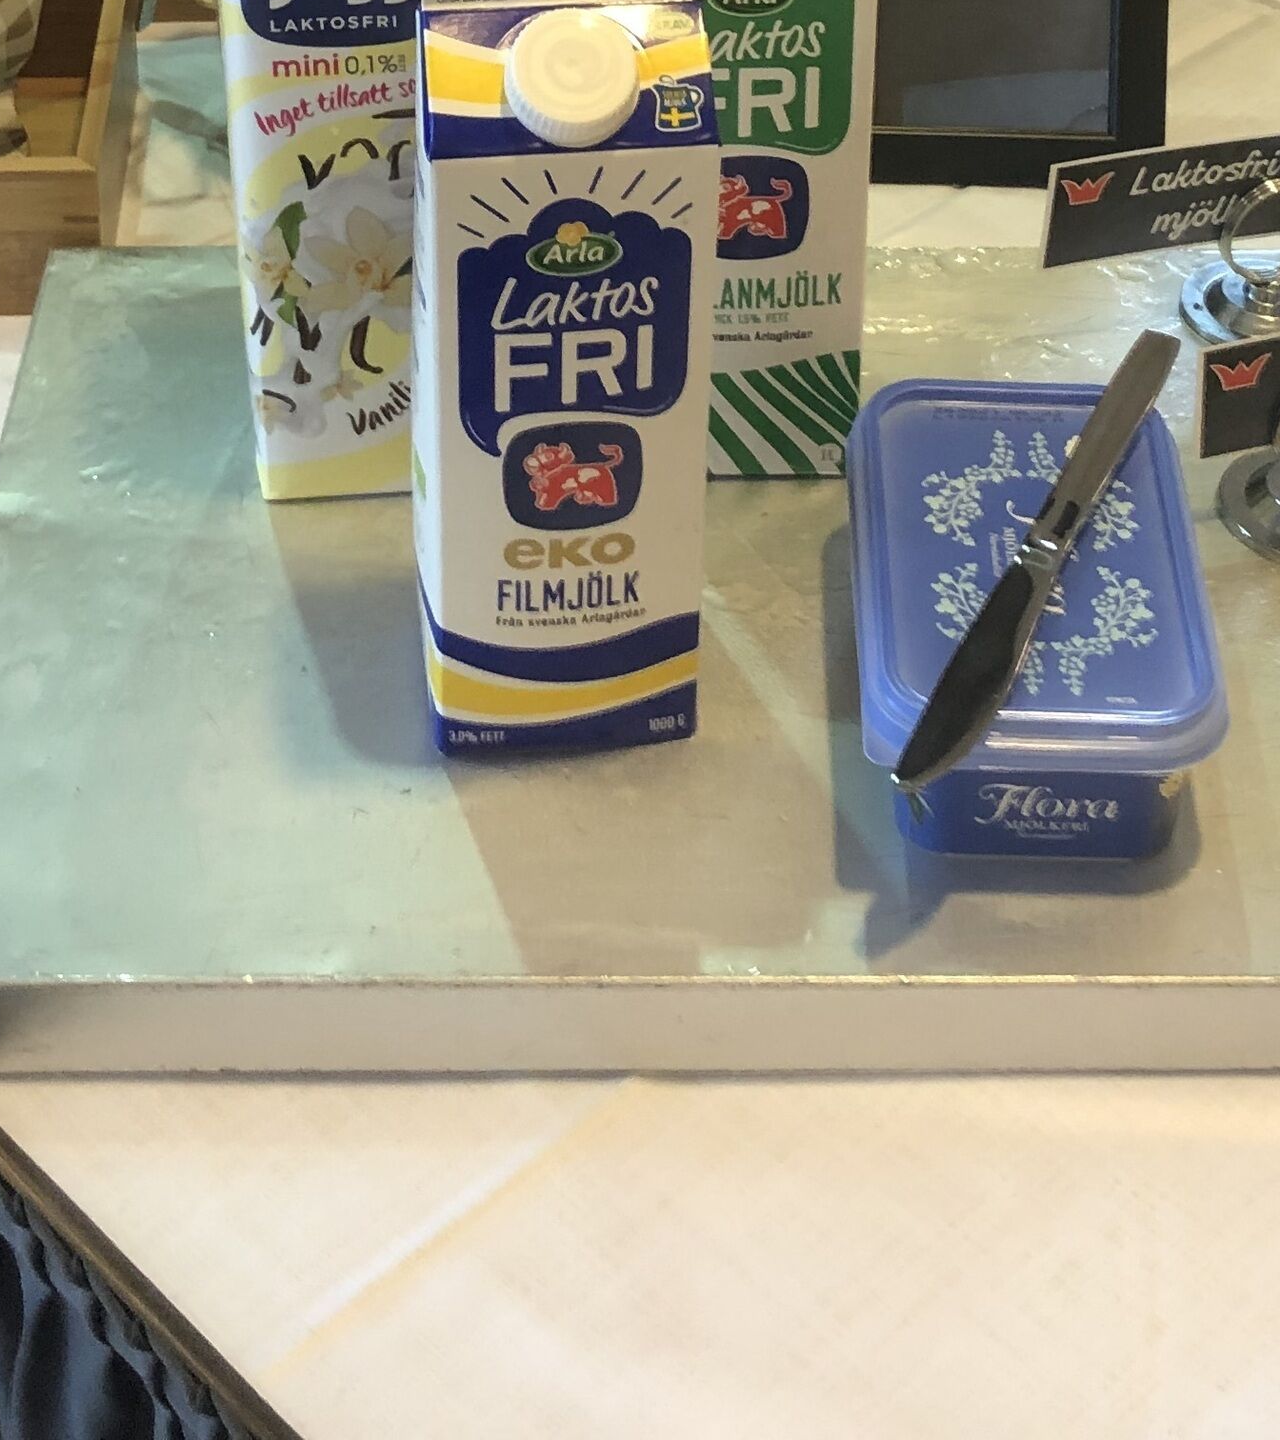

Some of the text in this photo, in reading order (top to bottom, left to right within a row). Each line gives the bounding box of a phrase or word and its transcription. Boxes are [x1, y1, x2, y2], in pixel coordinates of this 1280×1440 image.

[270, 15, 398, 33] LAKTOSFRI
[711, 19, 826, 62] aktos
[271, 53, 340, 78] mini
[345, 54, 398, 76] 0,1%
[253, 98, 314, 137] Inget
[317, 81, 393, 114] tillsatt
[542, 241, 605, 265] Arla
[491, 276, 660, 331] Laktos
[713, 270, 842, 309] ANMJÖLK
[494, 324, 654, 413] FRI
[503, 532, 636, 570] eko
[497, 570, 640, 612] FILMJÖLK
[496, 615, 524, 627] Från
[480, 730, 506, 744] FETT
[649, 716, 674, 732] 1000
[973, 783, 1119, 825] Flora
